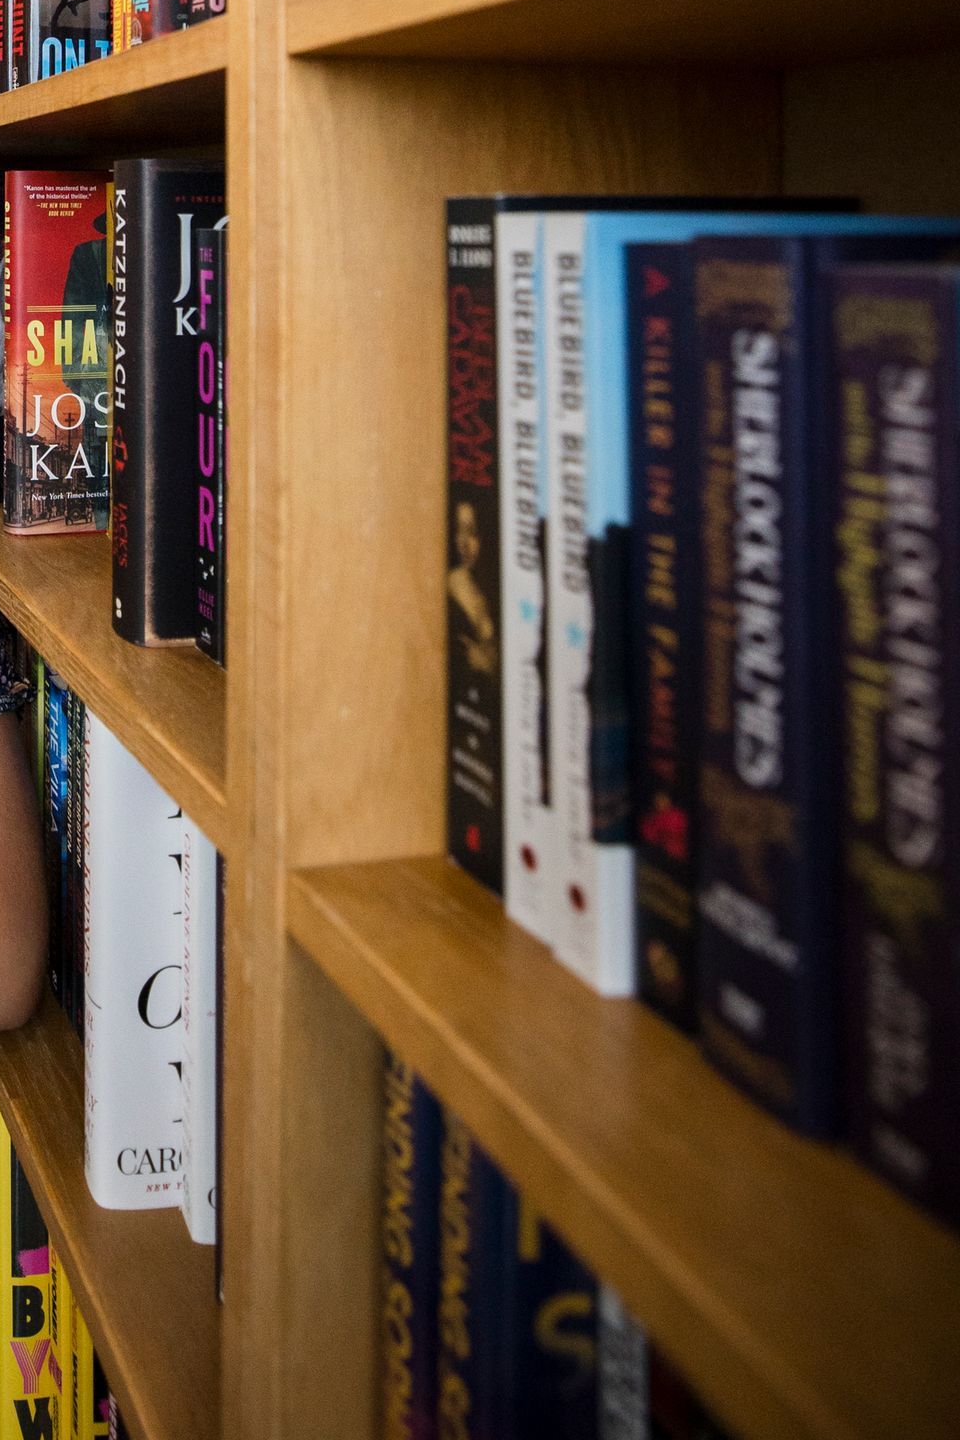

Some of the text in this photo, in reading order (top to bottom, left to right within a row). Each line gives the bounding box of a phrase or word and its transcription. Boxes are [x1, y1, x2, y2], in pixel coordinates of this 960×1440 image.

[115, 189, 127, 410] KATZENBACH
[199, 248, 213, 262] THE
[199, 270, 215, 552] FOUR
[31, 492, 47, 501] New
[49, 492, 64, 500] York
[66, 491, 85, 499] Times
[514, 417, 541, 574] BLUEBIRD
[560, 431, 590, 596] BLUEBIRD
[49, 702, 60, 832] THE VILLA
[146, 1183, 171, 1193] NEW
